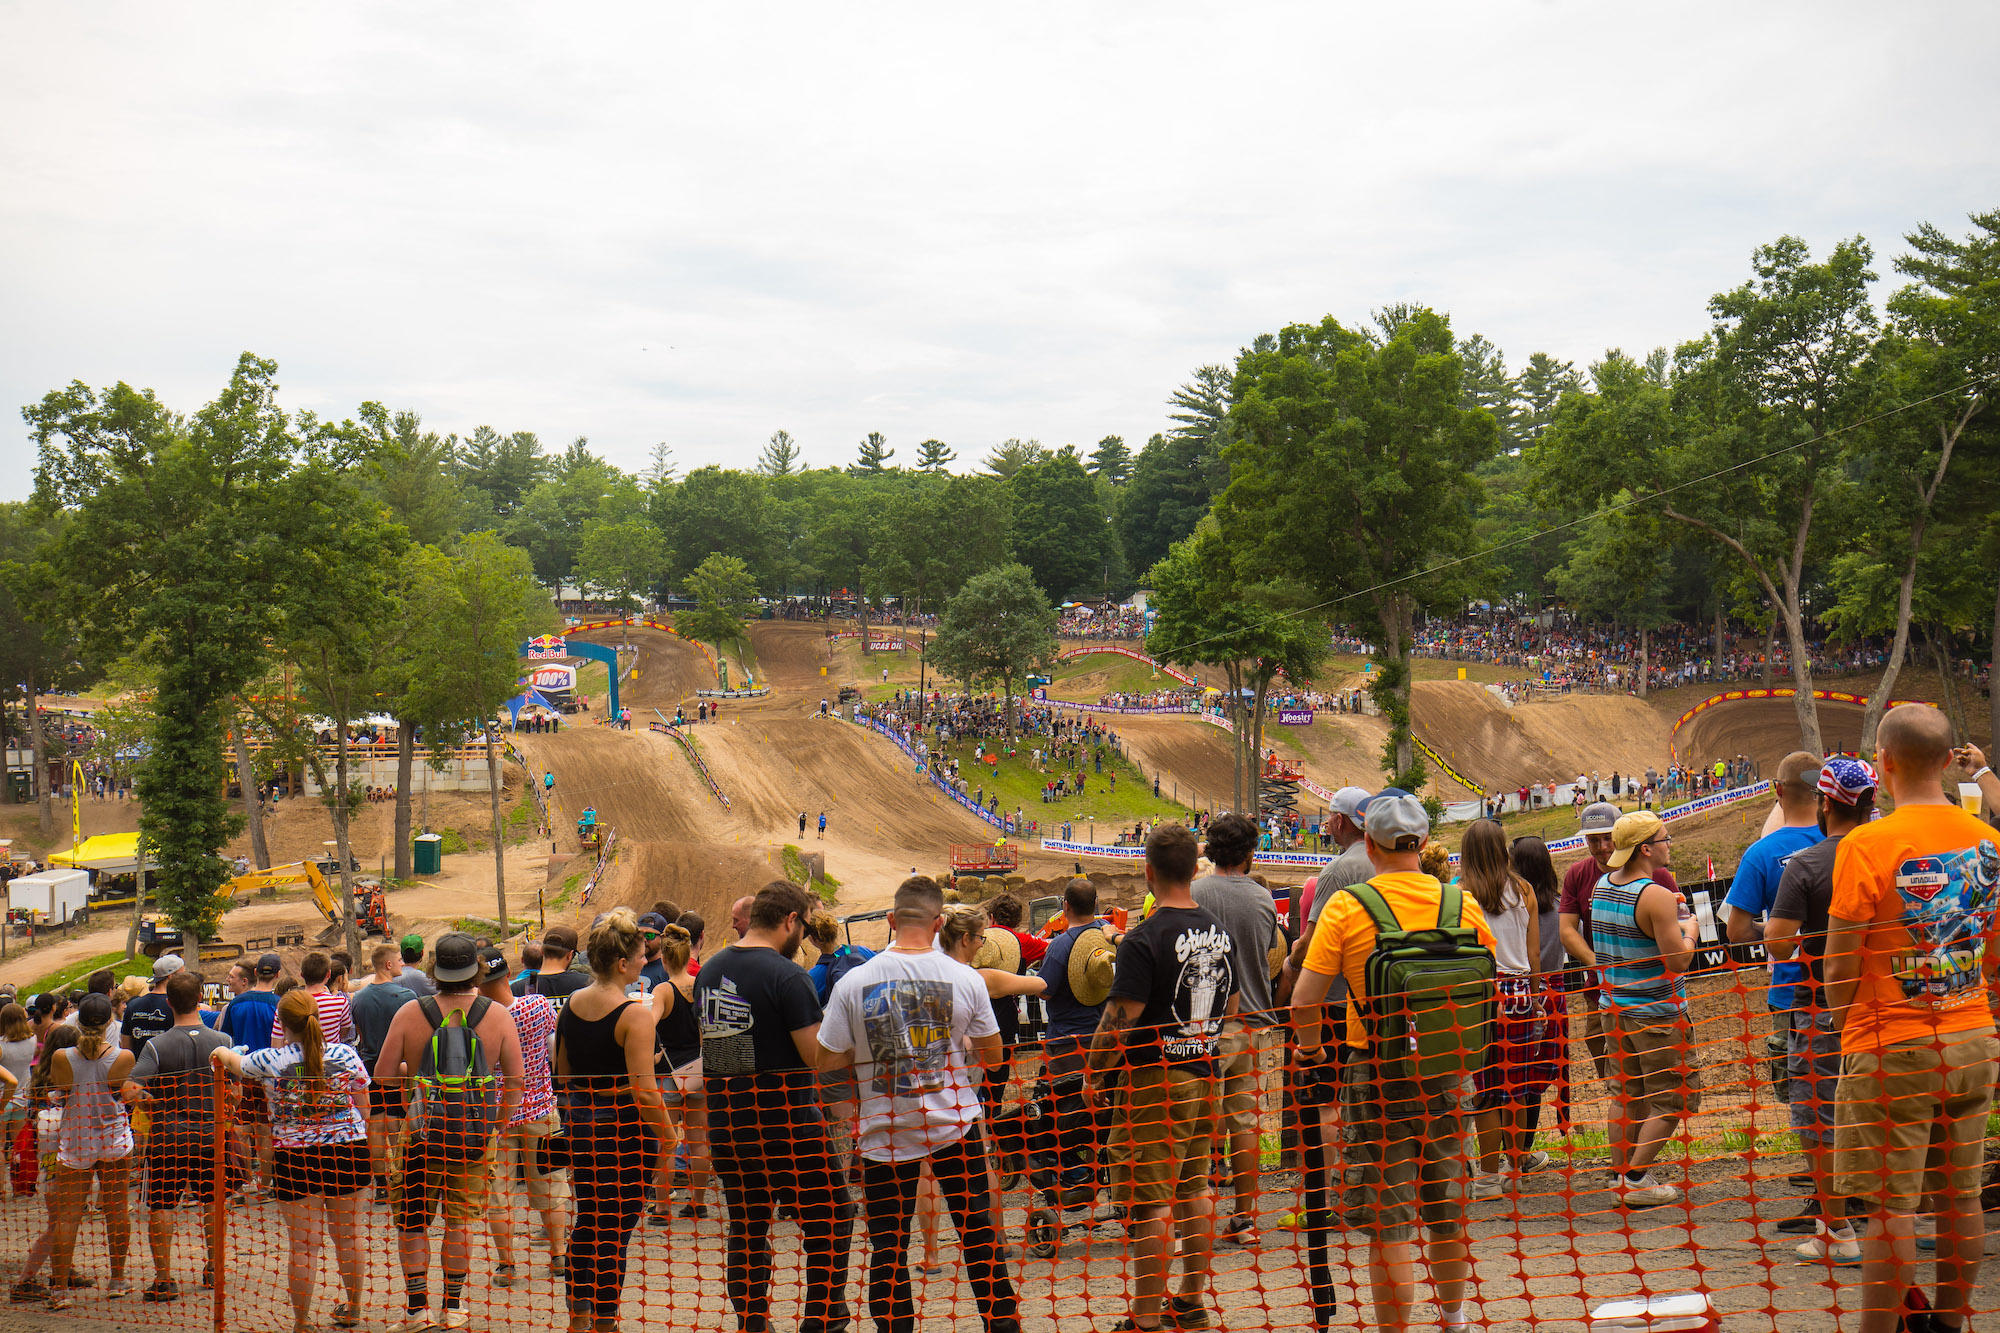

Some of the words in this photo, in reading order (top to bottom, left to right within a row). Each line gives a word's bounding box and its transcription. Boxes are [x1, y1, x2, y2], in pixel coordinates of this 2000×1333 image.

[870, 642, 890, 650] UCAS
[891, 642, 903, 650] OIL
[528, 649, 547, 659] Red
[548, 648, 567, 658] Bull
[535, 671, 568, 686] 100%
[1280, 712, 1312, 723] Hoosier
[1661, 806, 1690, 818] ARTS
[1691, 795, 1723, 810] PARTS
[1724, 786, 1753, 802] PARTS
[1754, 782, 1769, 794] PAR
[1063, 843, 1082, 851] PARTS
[1547, 837, 1584, 850] PARTS
[1284, 854, 1318, 862] PARTS
[1174, 923, 1232, 963] Stinky's
